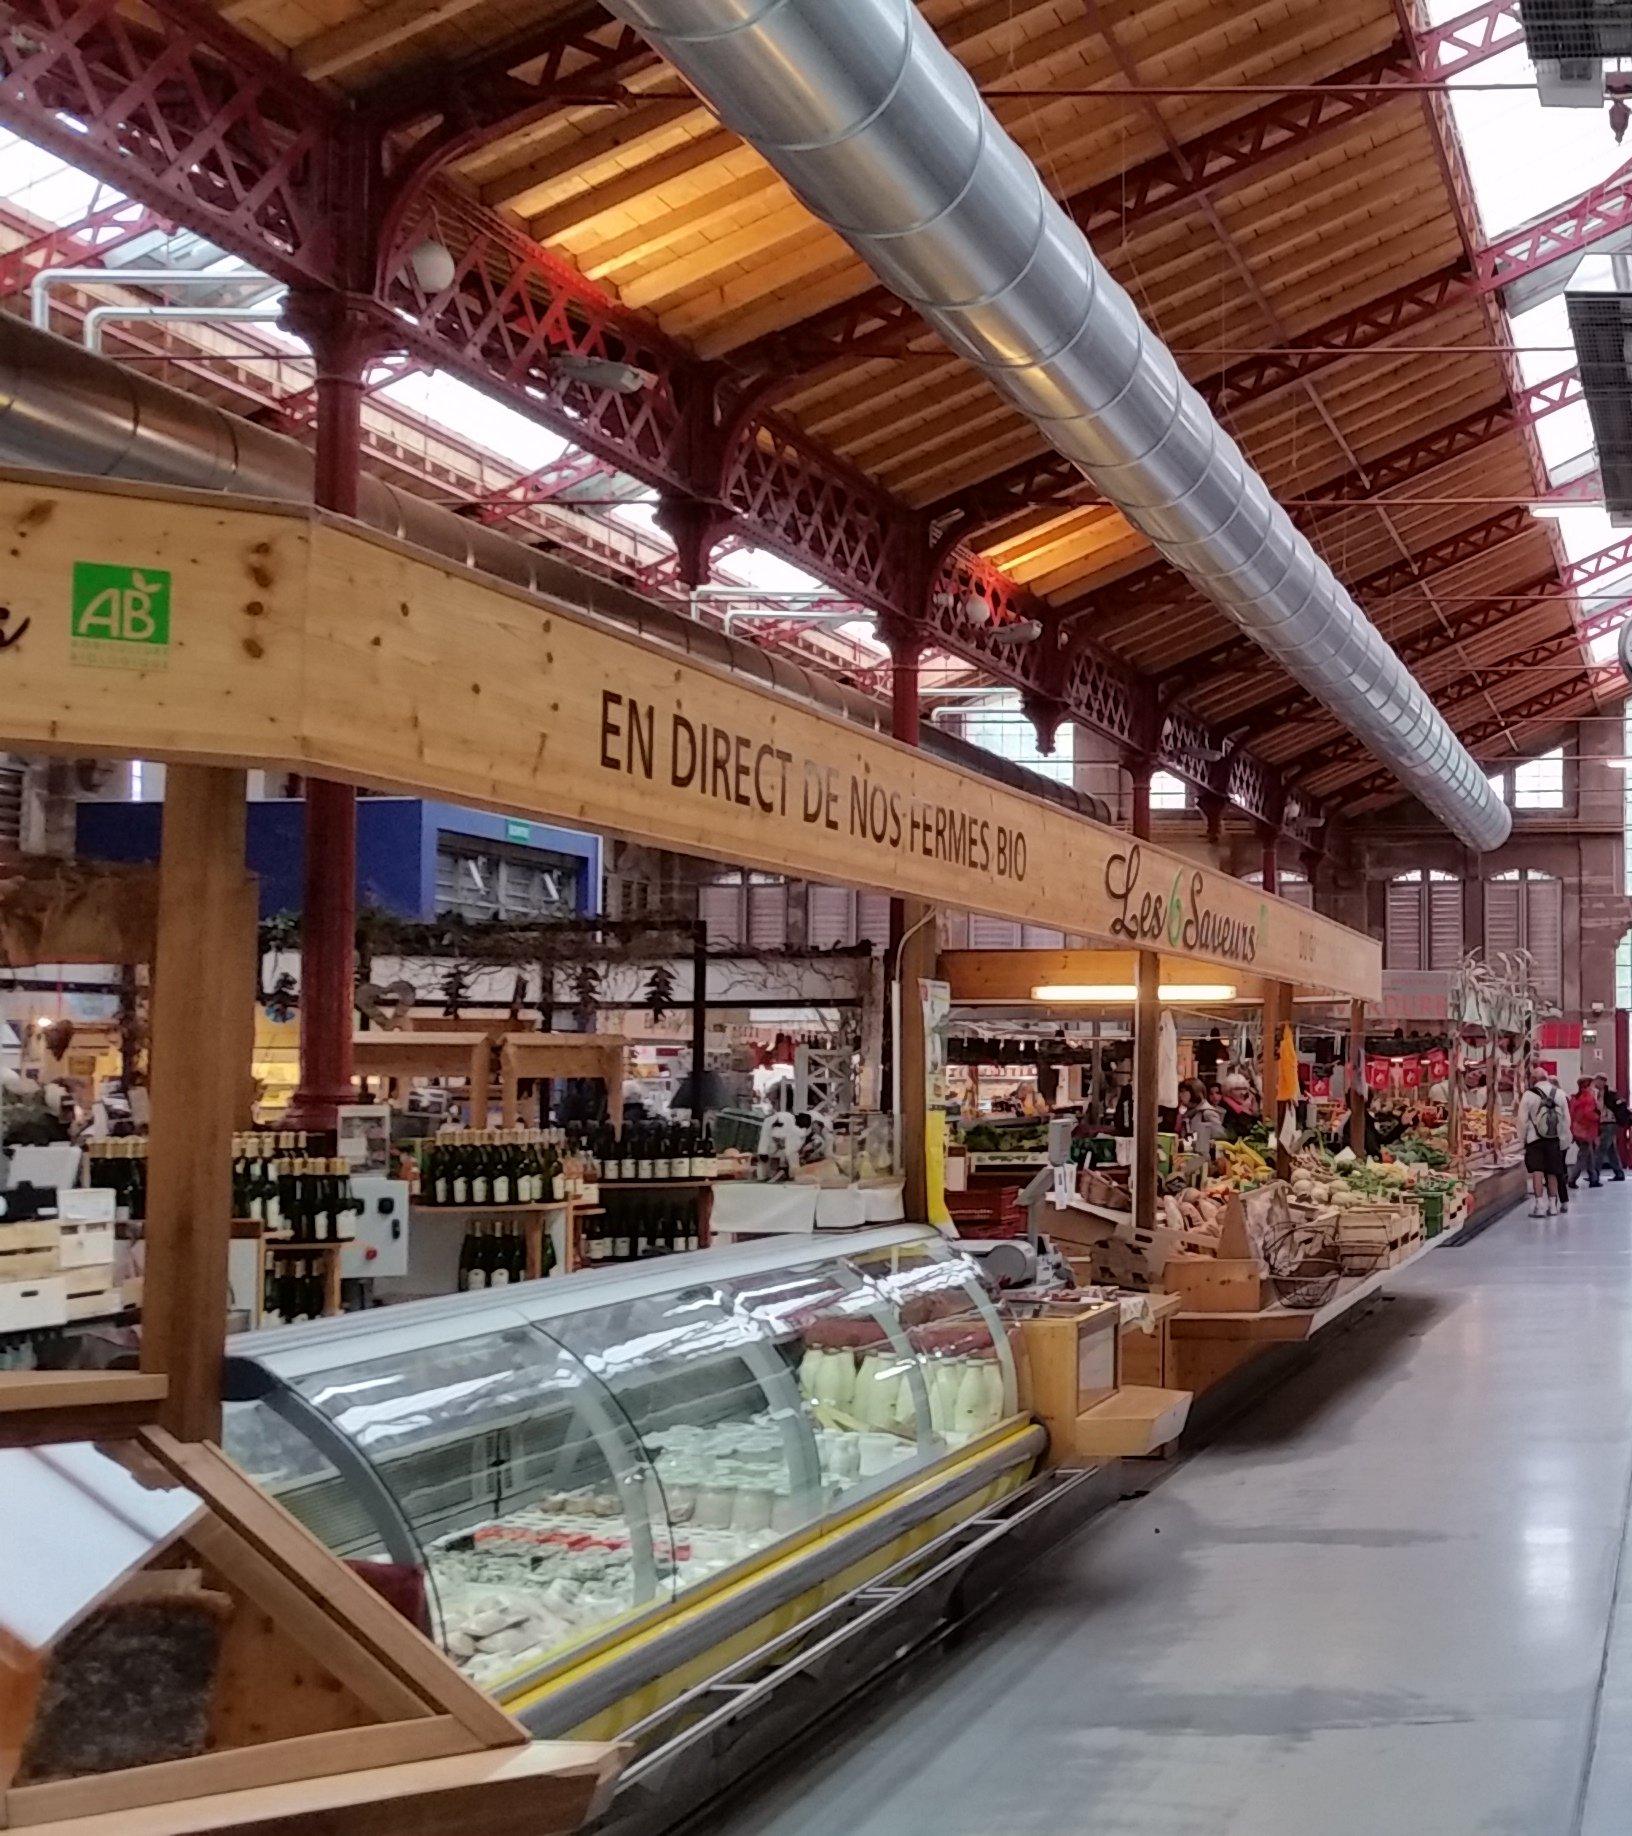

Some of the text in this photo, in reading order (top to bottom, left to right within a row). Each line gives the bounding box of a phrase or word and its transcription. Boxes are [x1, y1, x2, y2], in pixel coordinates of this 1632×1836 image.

[78, 587, 157, 640] AB
[600, 688, 1028, 882] EN DIRECT DE NOS FERMES BIO
[1104, 843, 1168, 940] Les
[1182, 870, 1257, 963] Saveurs
